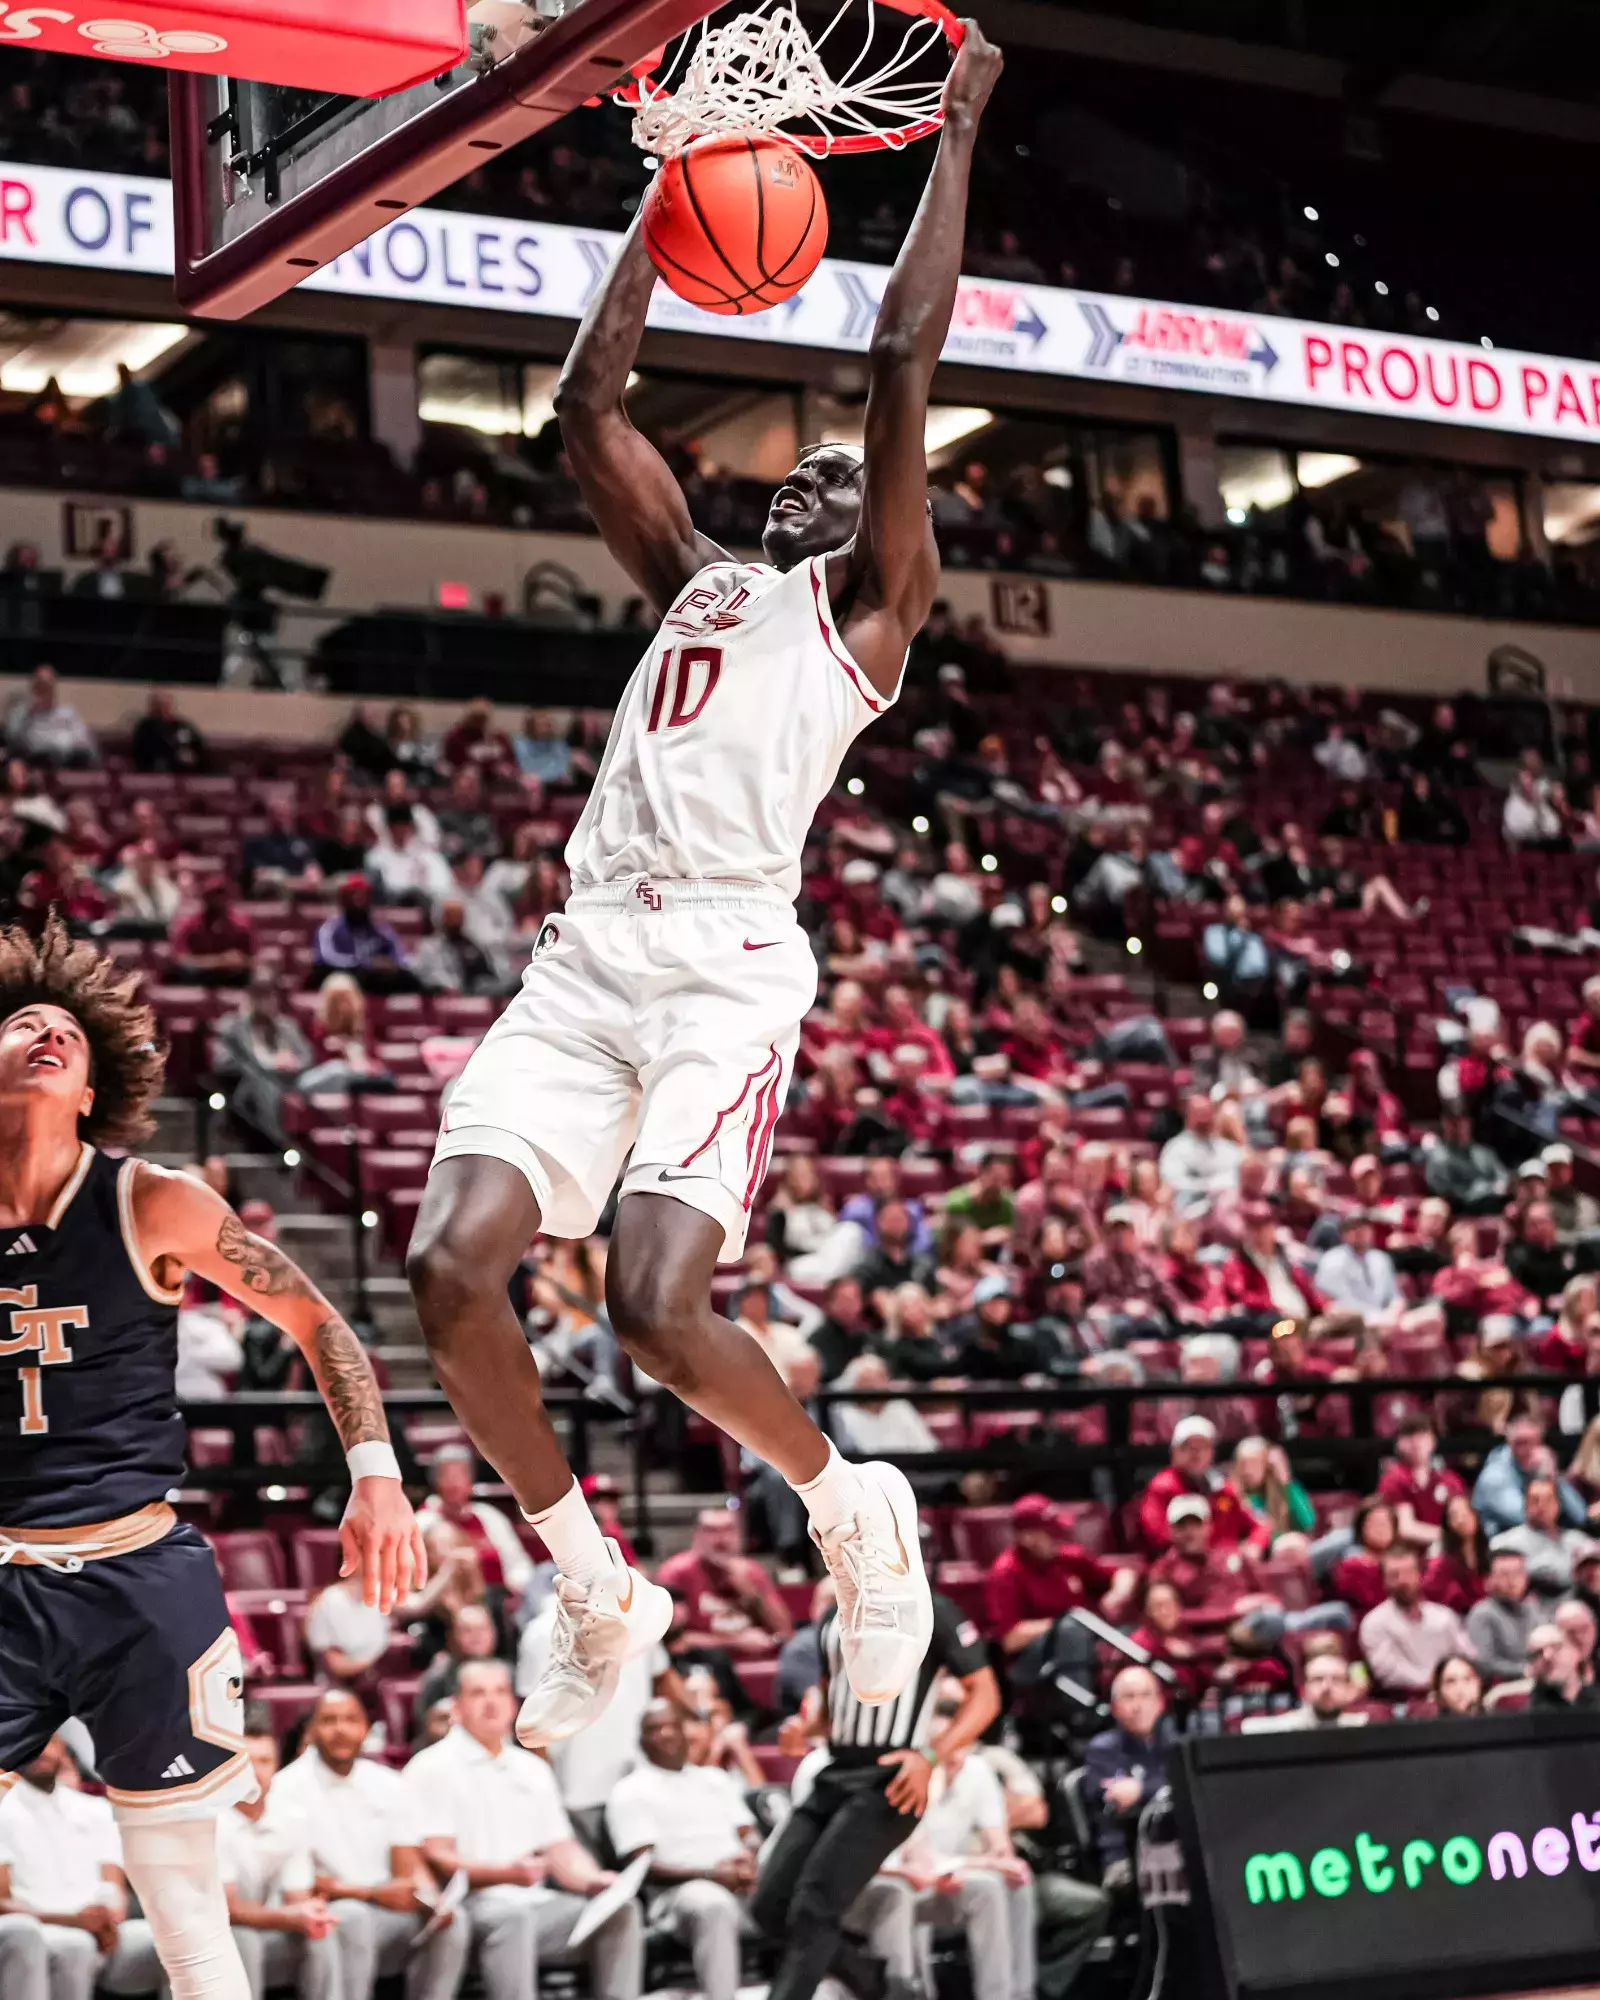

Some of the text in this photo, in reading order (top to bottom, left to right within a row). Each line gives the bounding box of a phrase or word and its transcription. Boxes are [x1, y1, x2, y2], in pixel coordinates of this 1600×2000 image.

[65, 187, 152, 253] OF
[1304, 336, 1501, 411] PROUD
[645, 645, 725, 735] 10
[635, 881, 662, 911] FSU
[18, 1366, 49, 1435] 1
[1245, 1811, 1600, 1904] metronet
